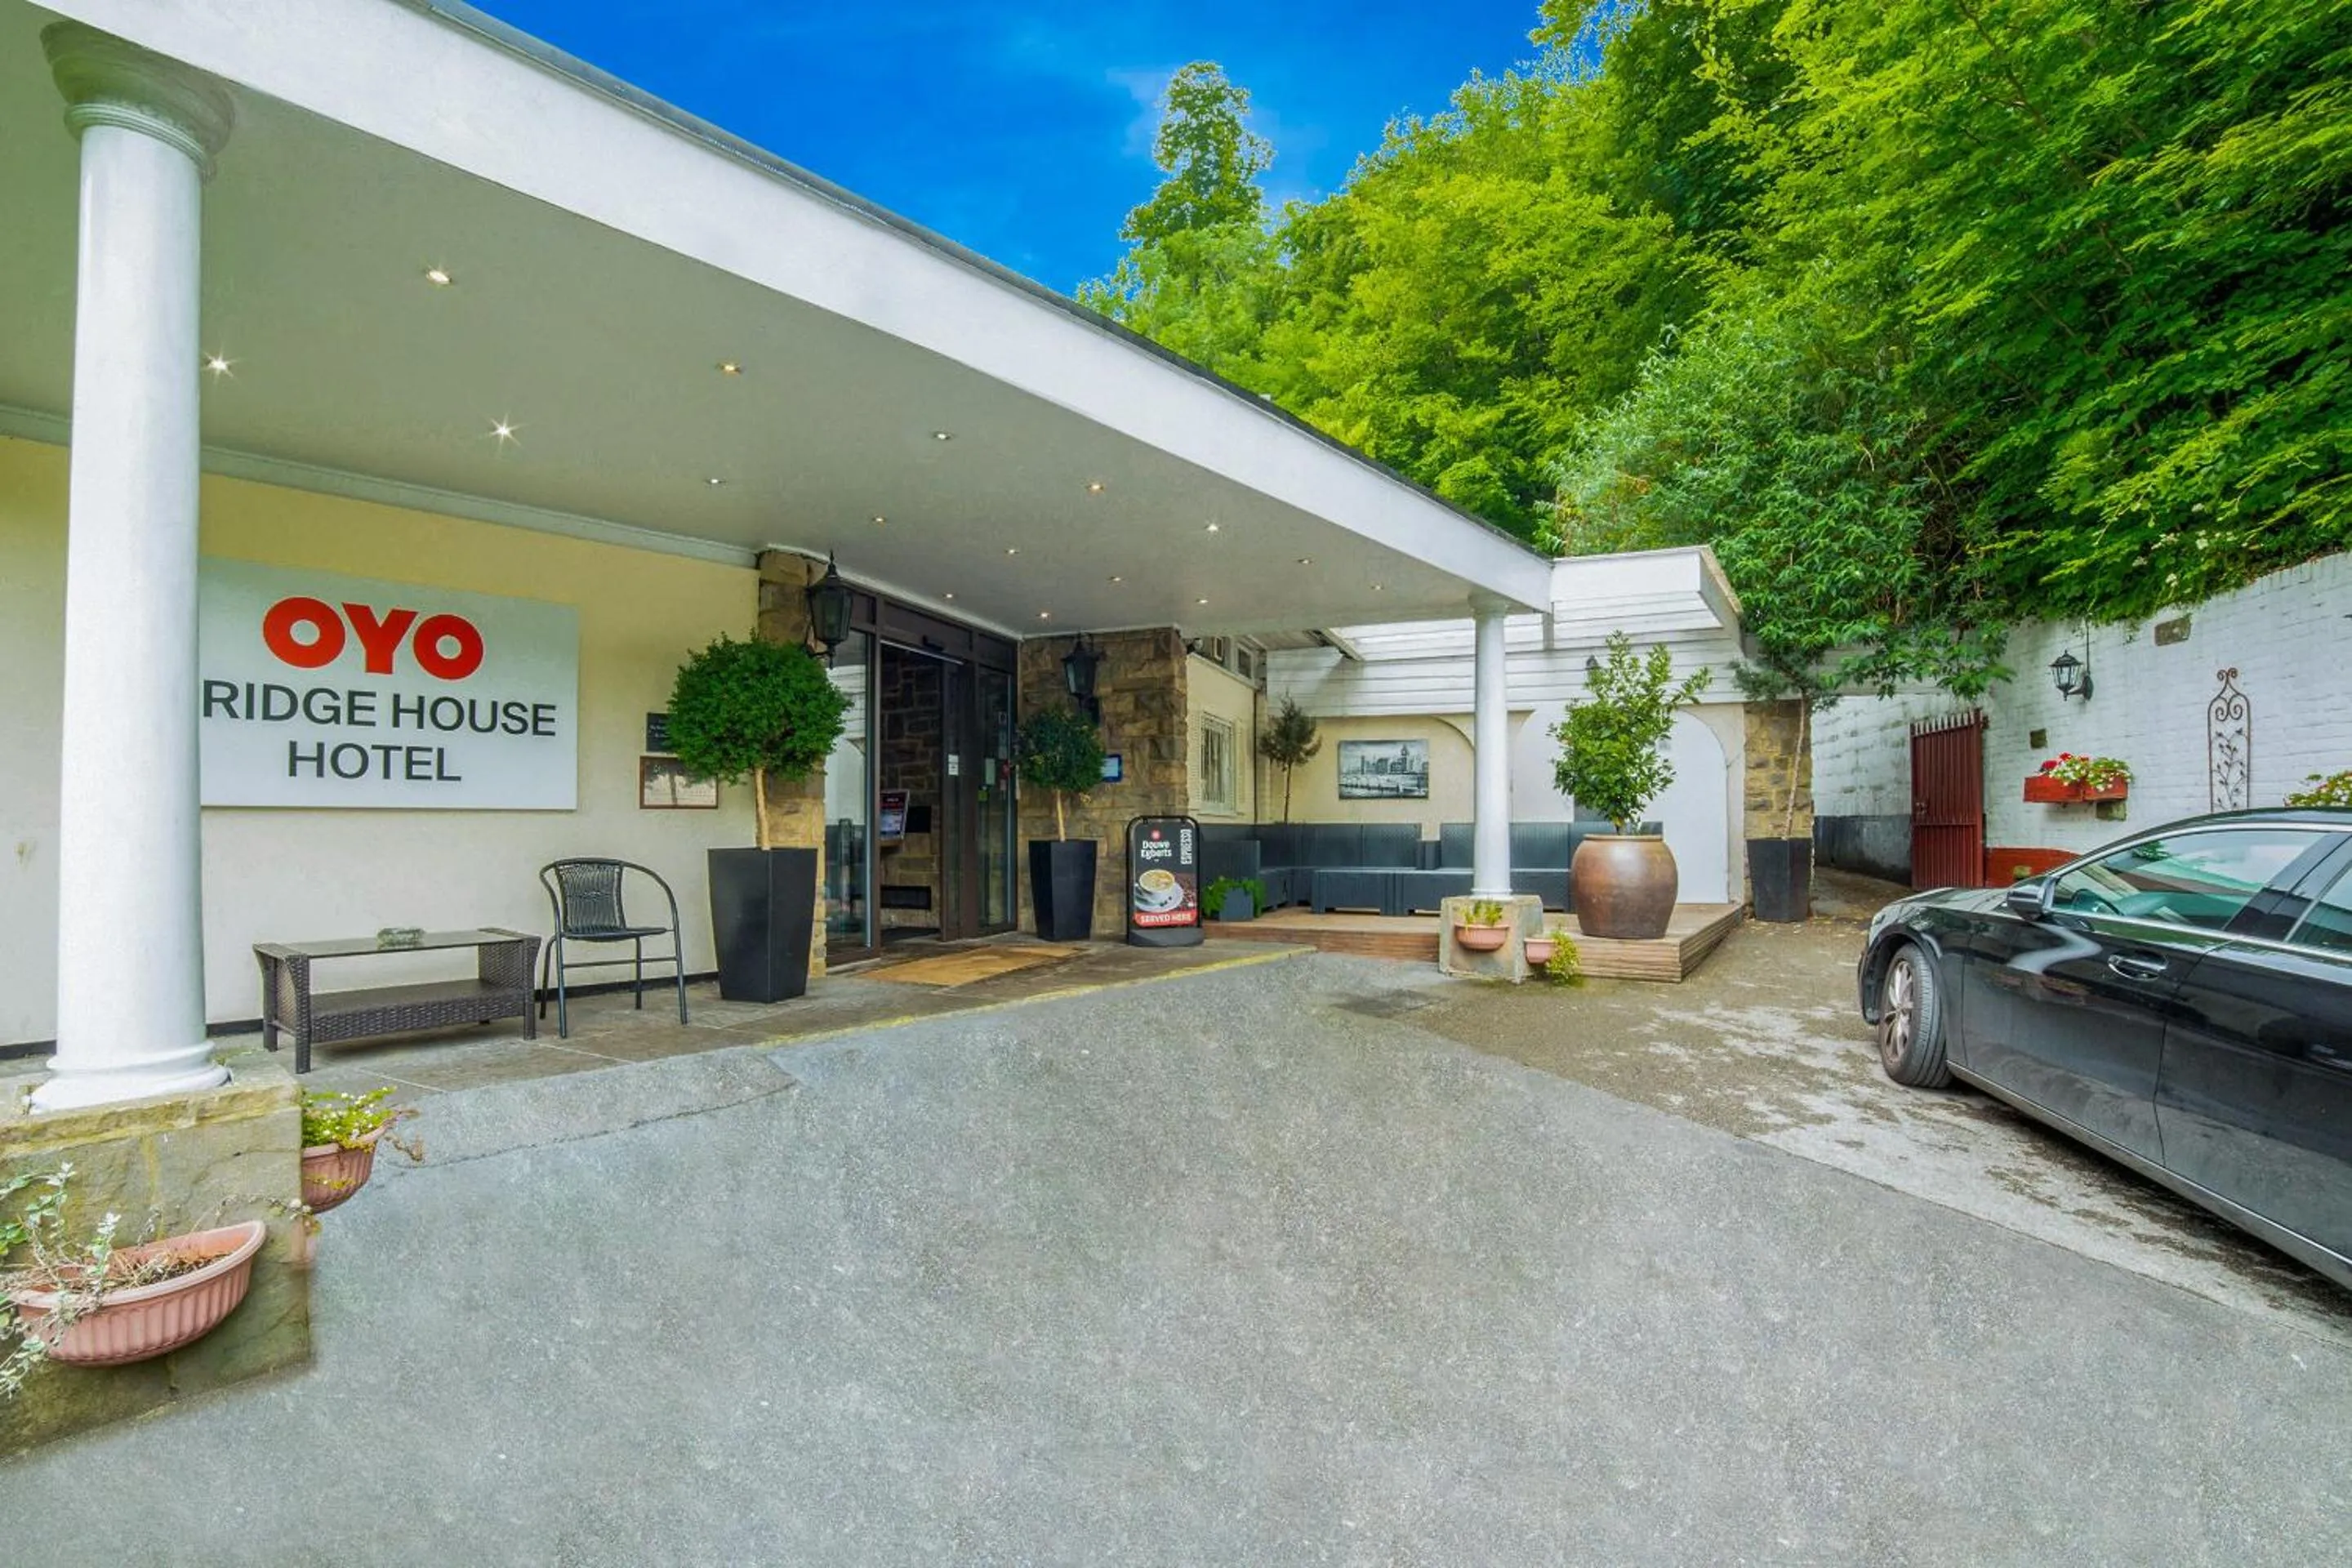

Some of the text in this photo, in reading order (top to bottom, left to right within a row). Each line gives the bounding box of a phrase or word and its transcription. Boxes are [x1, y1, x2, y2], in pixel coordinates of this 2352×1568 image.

[263, 597, 484, 680] OYO
[203, 679, 556, 736] RIDGE HOUSE
[287, 741, 461, 782] HOTEL
